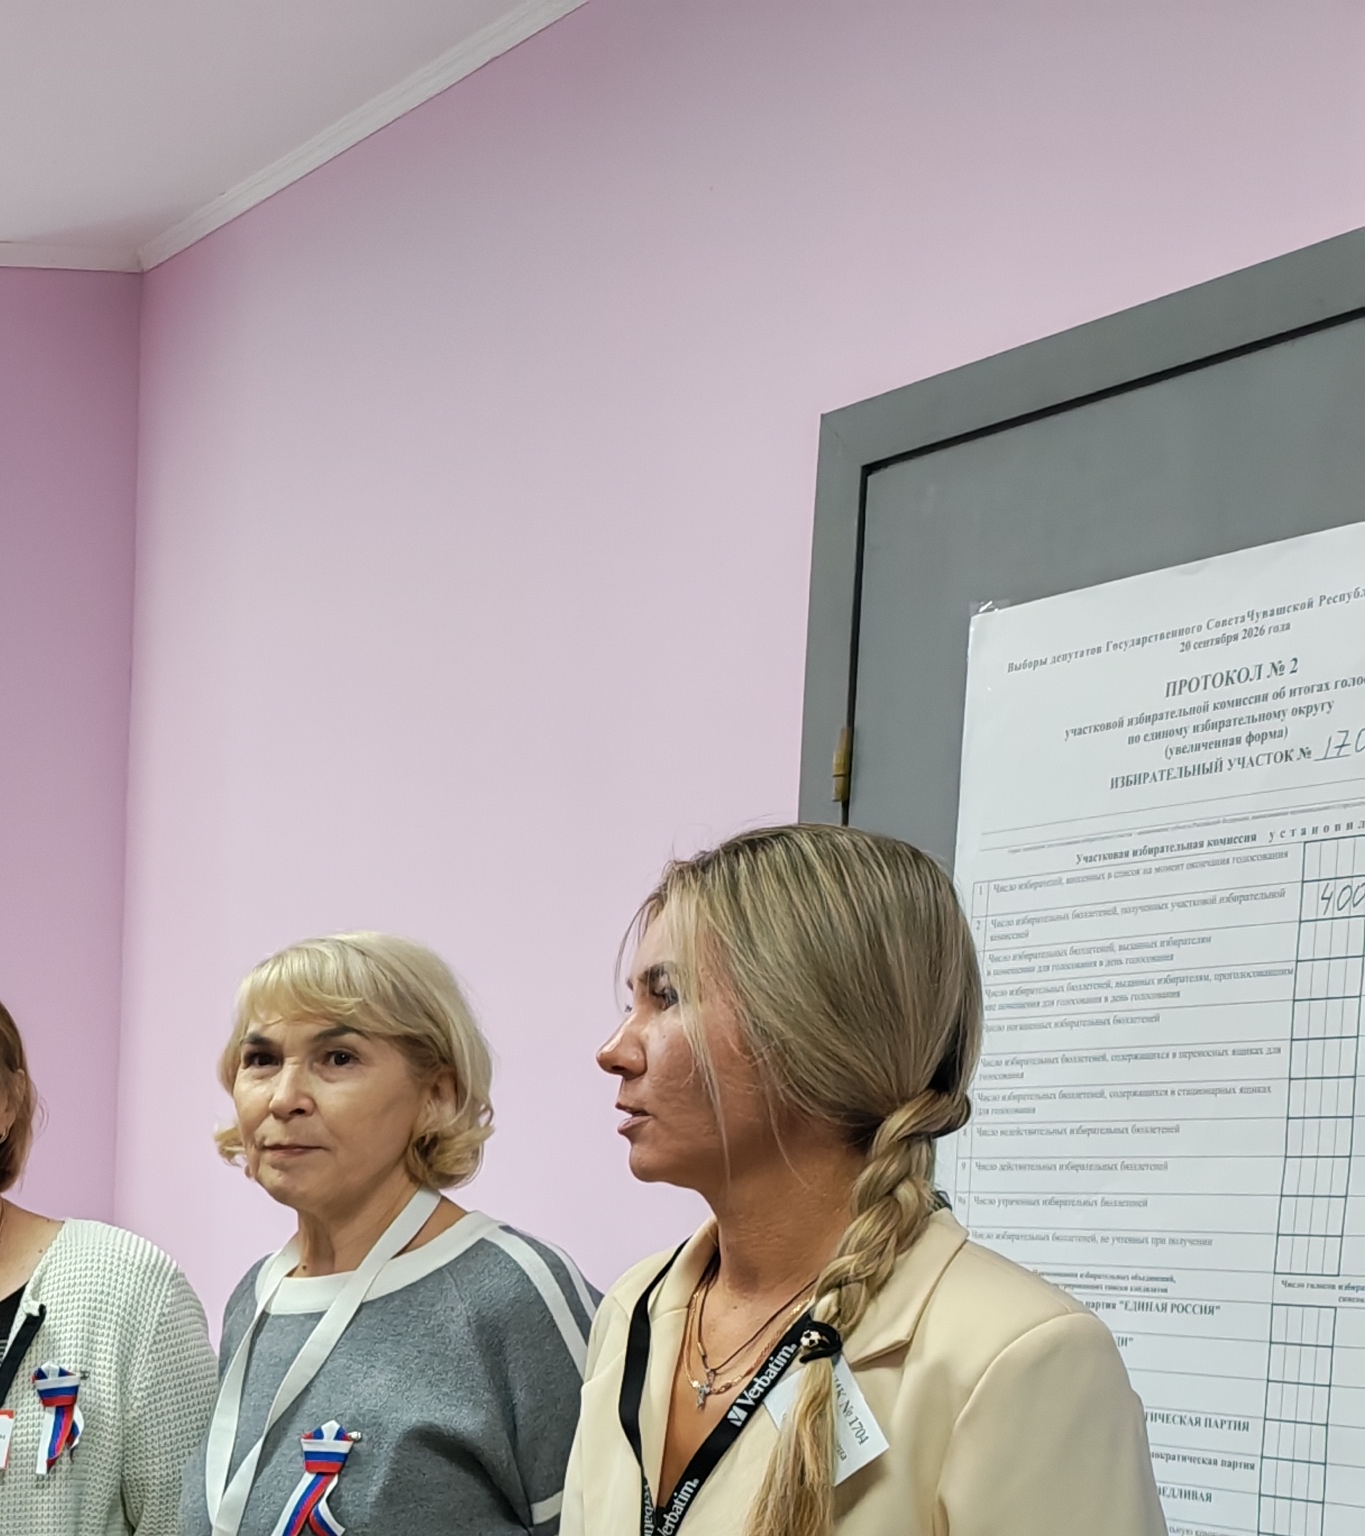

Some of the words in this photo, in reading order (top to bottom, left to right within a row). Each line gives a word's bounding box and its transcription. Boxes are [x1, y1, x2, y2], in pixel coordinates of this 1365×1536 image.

[1007, 656, 1048, 673] Выборы
[1050, 645, 1102, 664] депутатов
[1105, 623, 1203, 653] Государственного
[1179, 641, 1191, 652] 20
[1193, 632, 1239, 650] сентября
[1241, 625, 1265, 641] 2026
[1268, 621, 1291, 635] года
[1165, 663, 1263, 698] ПРОТОКОЛ
[1266, 660, 1285, 678] №
[1289, 657, 1298, 674] 2
[1064, 716, 1124, 741] участковой
[1127, 700, 1209, 727] избирательной
[1212, 692, 1269, 711] комиссии
[1272, 686, 1286, 701] об
[1289, 681, 1330, 698] итогах
[1127, 734, 1141, 745] по
[1143, 725, 1189, 742] единому
[1192, 708, 1288, 733] избирательному
[1291, 700, 1334, 718] округу
[1165, 734, 1242, 760] (увеличенная
[1245, 726, 1289, 748] форма)
[1110, 757, 1223, 790] ИЗБИРАТЕЛЬНЫЙ
[1227, 748, 1295, 771] УЧАСТОК
[1297, 746, 1312, 760] №
[1076, 849, 1129, 865] Участковая
[1132, 840, 1204, 858] избирательная
[1207, 833, 1257, 847] комиссия
[1119, 1300, 1167, 1314] "ЕДИНАЯ
[1170, 1303, 1220, 1316] РОССИЯ"
[739, 1349, 793, 1409] Verbatim
[848, 1415, 869, 1446] 1704
[1145, 1411, 1202, 1428] ИЧЕСКАЯ
[1204, 1417, 1250, 1432] ПАРТИЯ
[1221, 1459, 1255, 1471] партия
